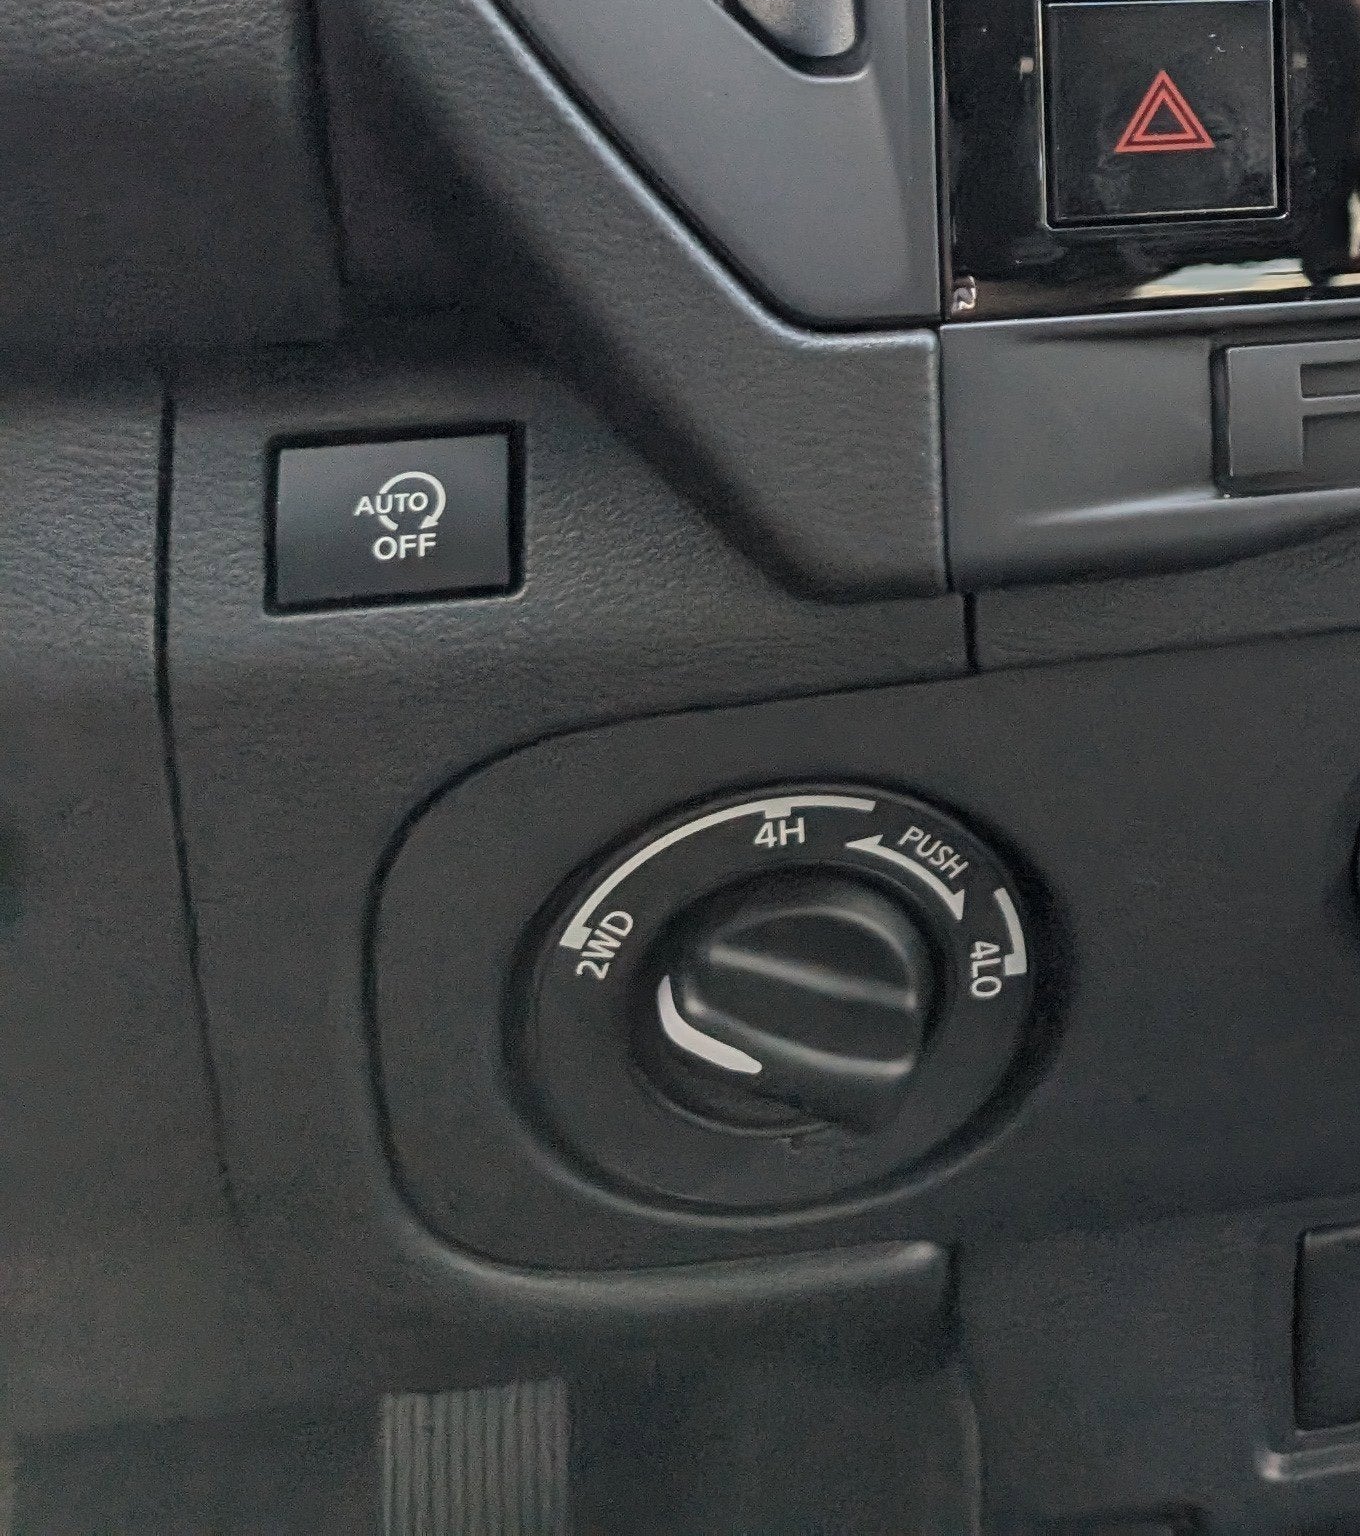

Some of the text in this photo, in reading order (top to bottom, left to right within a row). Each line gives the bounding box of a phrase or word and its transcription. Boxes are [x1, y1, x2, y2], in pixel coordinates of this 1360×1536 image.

[354, 490, 429, 517] AUTO
[372, 532, 437, 562] OFF
[752, 817, 806, 849] 4H
[897, 825, 970, 880] PUSH
[575, 909, 636, 981] 2WD
[969, 939, 1003, 1000] 4LO
